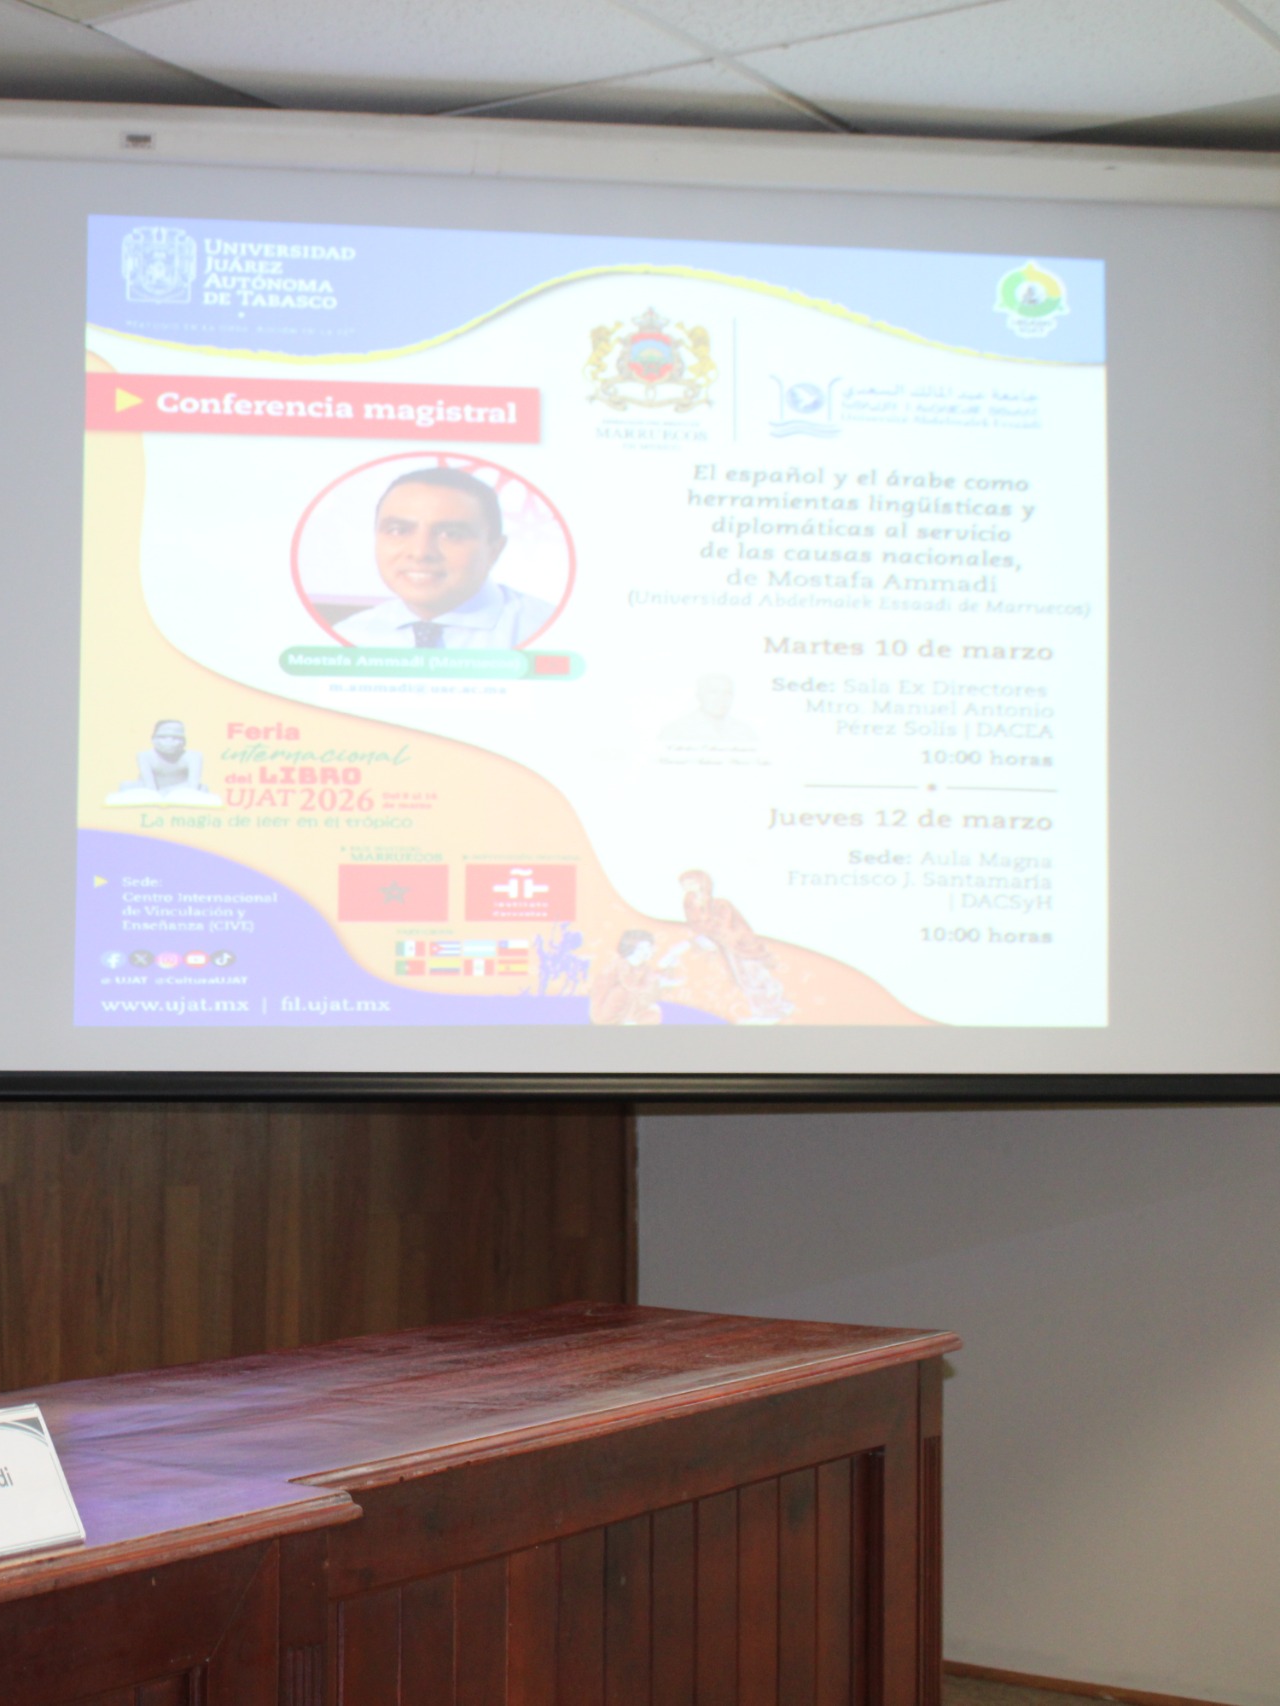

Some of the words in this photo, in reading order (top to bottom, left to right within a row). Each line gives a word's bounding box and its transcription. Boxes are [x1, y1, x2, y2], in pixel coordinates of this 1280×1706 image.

[203, 238, 357, 262] UNIVERSIDAD
[204, 256, 283, 275] JUÁREZ
[203, 273, 334, 293] AUTÓNOMA
[236, 290, 338, 310] TABASCO
[155, 391, 354, 419] Conferencia
[363, 400, 517, 428] magistral
[692, 464, 717, 482] El
[724, 466, 824, 489] español
[832, 472, 848, 491] y
[856, 468, 877, 487] el
[886, 469, 957, 490] árabe
[963, 476, 1030, 493] como
[687, 488, 859, 512] herramientas
[868, 494, 1012, 519] lingüísticas
[1020, 503, 1036, 522] y
[711, 516, 876, 539] diplomáticas
[884, 519, 908, 539] al
[916, 523, 1012, 544] servicio
[699, 541, 729, 561] de
[737, 541, 774, 562] las
[783, 547, 872, 564] causas
[881, 547, 1022, 573] nacionales,
[726, 567, 758, 587] de
[766, 569, 875, 590] Mostafa
[762, 636, 865, 656] Martes
[875, 639, 909, 657] 10
[917, 638, 952, 658] de
[962, 644, 1055, 662] marzo
[770, 677, 836, 693] Sede:
[843, 678, 890, 695] Sala
[898, 679, 924, 696] Ex
[932, 680, 1048, 698] Directores
[871, 700, 957, 716] Manuel
[964, 702, 1055, 719] Antonio
[226, 721, 301, 741] Feria
[835, 719, 896, 736] Pérez
[976, 722, 1055, 739] DACEA
[220, 743, 412, 766] internacional
[920, 749, 982, 766] 10:00
[989, 749, 1054, 767] horas
[224, 772, 253, 785] del
[258, 766, 363, 786] LIBRO
[225, 787, 296, 810] UJAT
[299, 787, 376, 812] 2026
[139, 813, 164, 828] La
[170, 814, 222, 830] magia
[227, 813, 251, 828] de
[296, 817, 319, 829] en
[345, 815, 414, 830] trópico
[767, 807, 865, 830] Jueves
[875, 809, 908, 828] 12
[917, 808, 952, 829] de
[962, 814, 1054, 831] marzo
[847, 849, 912, 866] Sede:
[920, 851, 971, 867] Aula
[978, 852, 1053, 872] Magna
[122, 876, 163, 888] Sede:
[786, 869, 897, 887] Francisco
[922, 871, 1053, 890] Santamaría
[122, 892, 173, 903] Centro
[960, 892, 1054, 914] DACSyH
[122, 905, 141, 917] de
[920, 926, 981, 943] 10:00
[988, 926, 1054, 944] horas
[101, 995, 250, 1015] www.ujat.mx
[280, 995, 391, 1015] fil.ujat.mx
